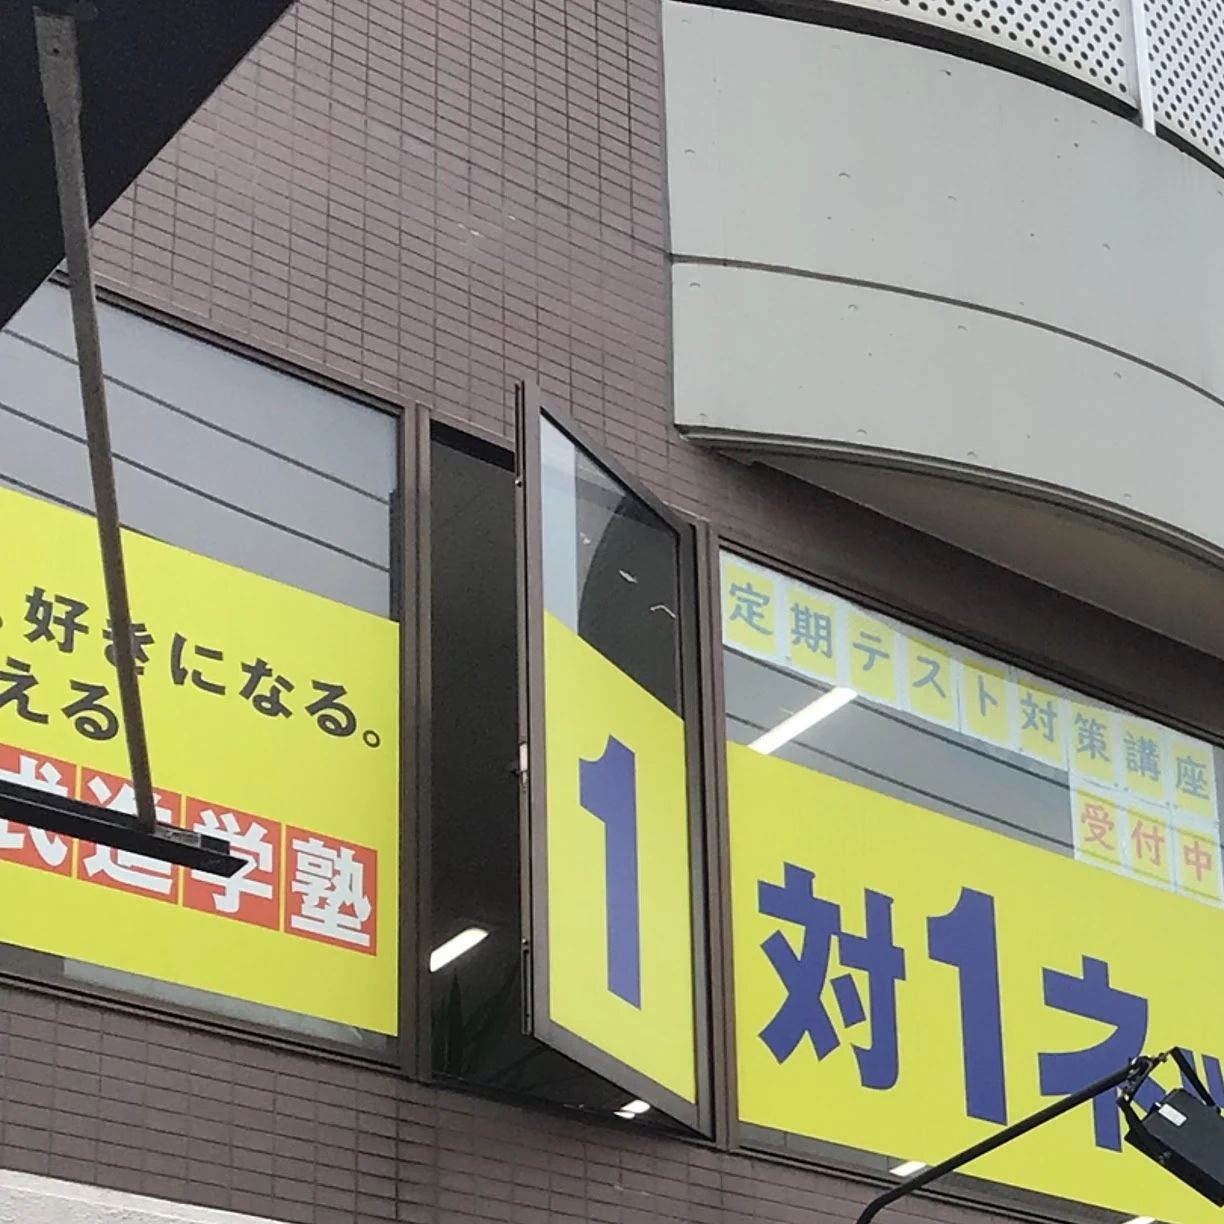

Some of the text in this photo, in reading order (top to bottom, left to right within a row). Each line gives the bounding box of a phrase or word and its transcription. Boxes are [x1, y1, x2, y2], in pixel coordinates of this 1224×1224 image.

[0, 586, 381, 748] 好きになる。
[729, 583, 1211, 801] 定期テスト対策講座
[1080, 802, 1214, 882] 受付中
